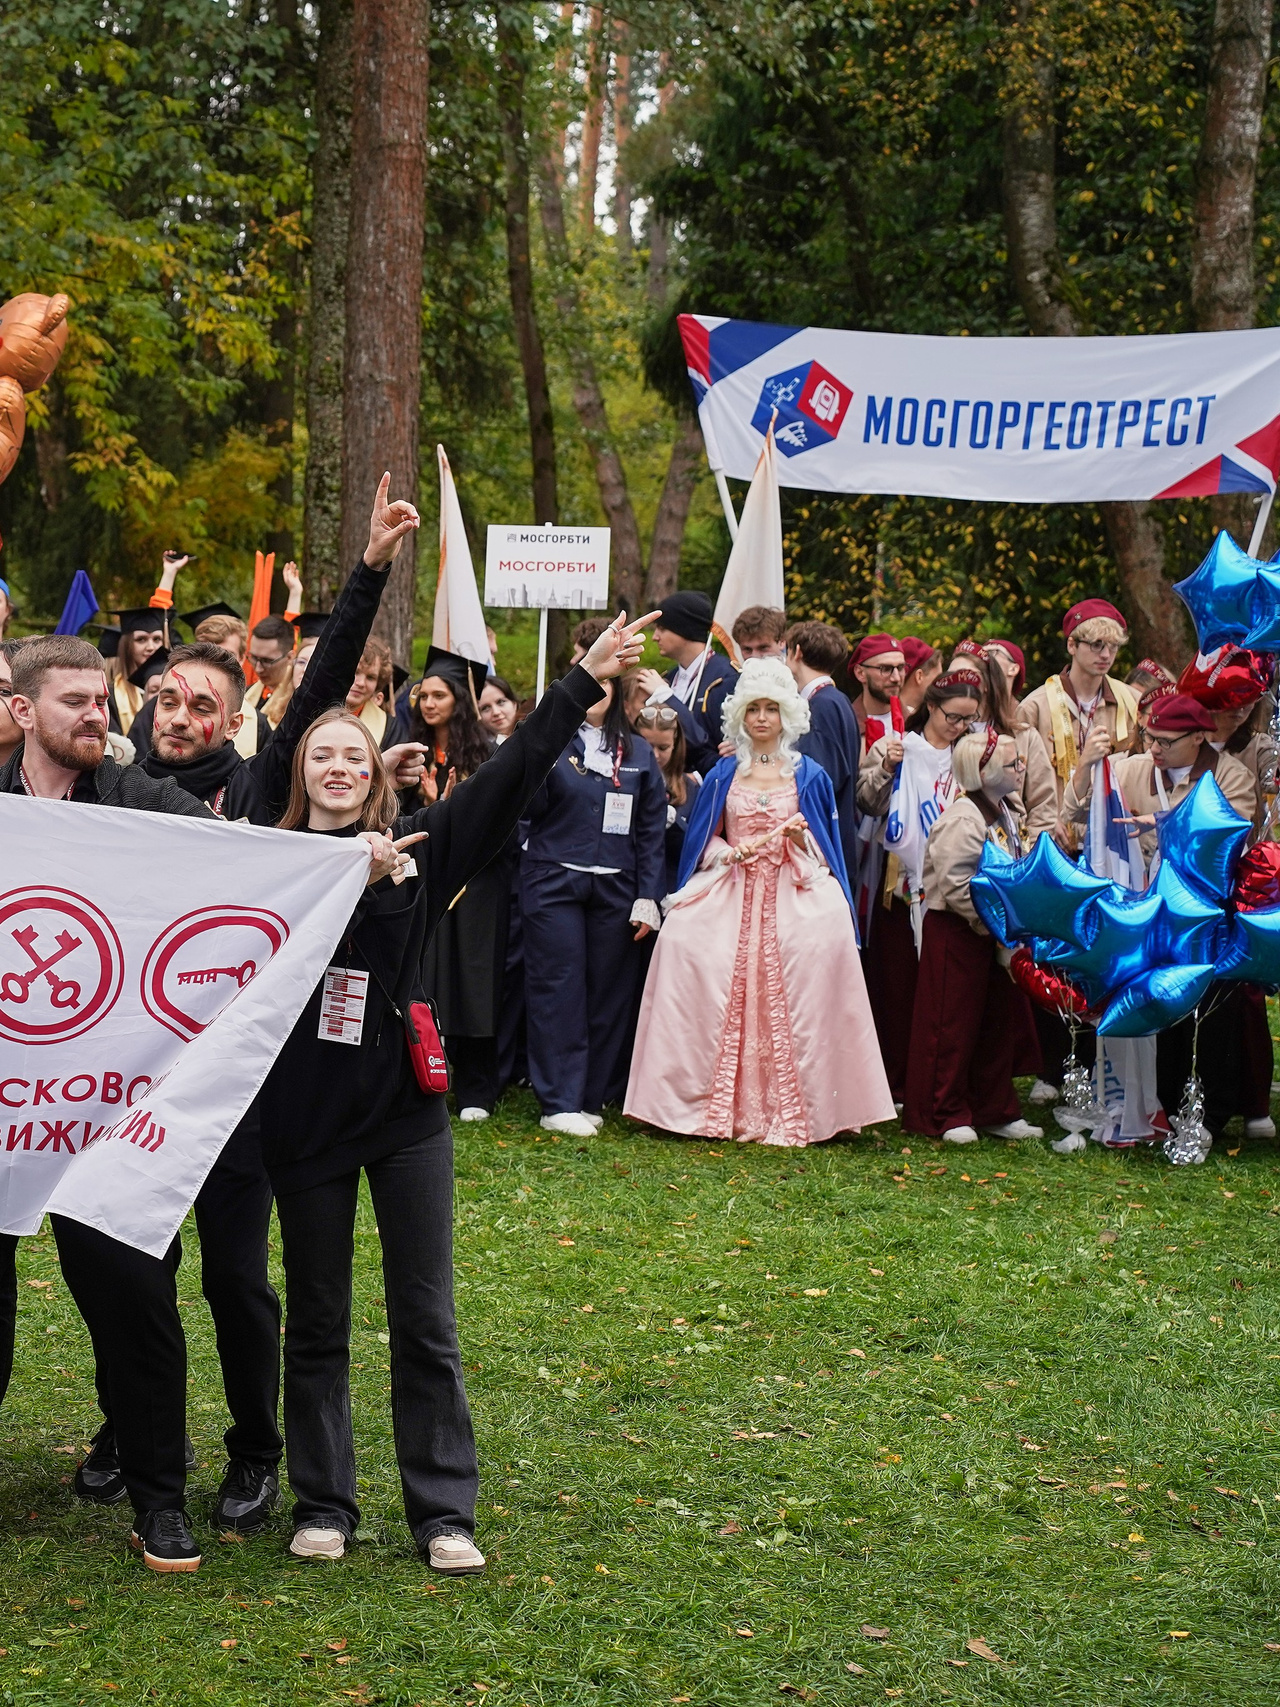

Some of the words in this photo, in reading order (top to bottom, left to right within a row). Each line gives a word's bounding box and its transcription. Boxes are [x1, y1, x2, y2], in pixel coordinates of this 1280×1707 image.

[862, 394, 1217, 451] МОСГОРГЕОТРЕСТ
[519, 533, 590, 544] МОСГОРБТИ
[498, 560, 596, 573] МОСГОРБТИ
